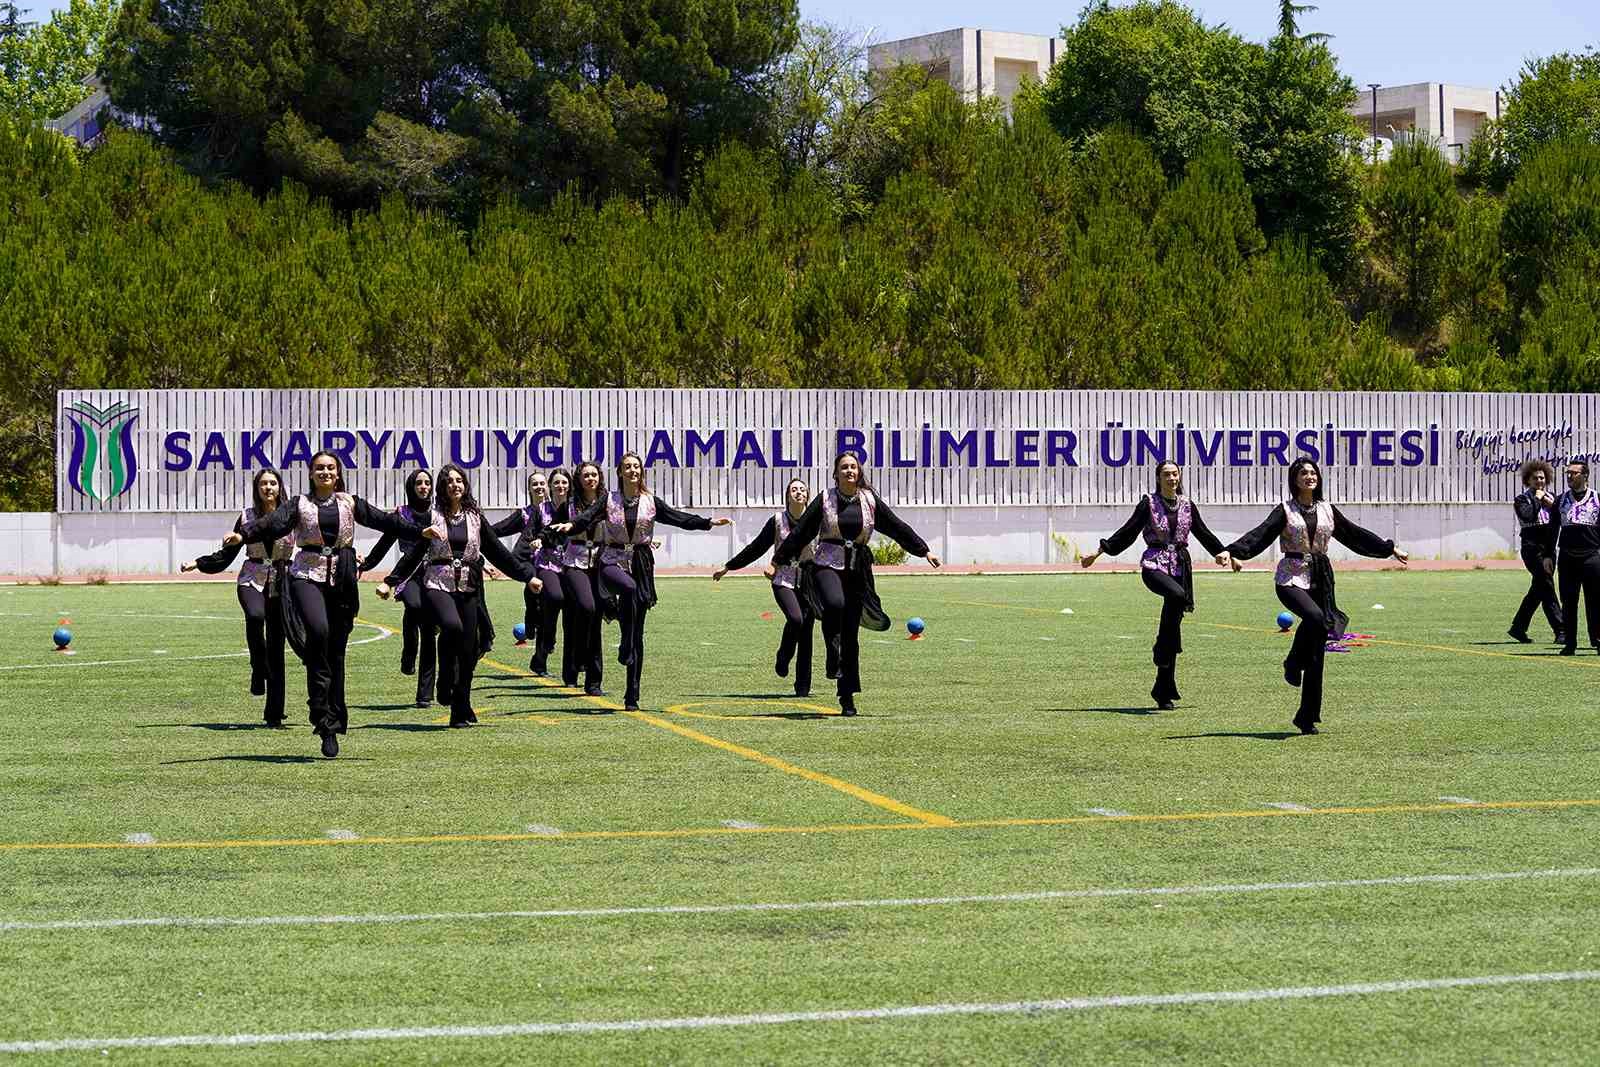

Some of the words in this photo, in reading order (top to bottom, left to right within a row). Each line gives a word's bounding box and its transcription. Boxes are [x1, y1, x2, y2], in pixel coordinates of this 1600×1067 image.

[164, 430, 429, 471] SAKARYA
[450, 430, 813, 469] UYGULAMALI
[837, 423, 1078, 468] BİLİMLER
[1100, 422, 1439, 467] ÜNİVERSİTESİ
[1456, 430, 1504, 459] Bilgiyi
[1509, 420, 1572, 448] beceriyle
